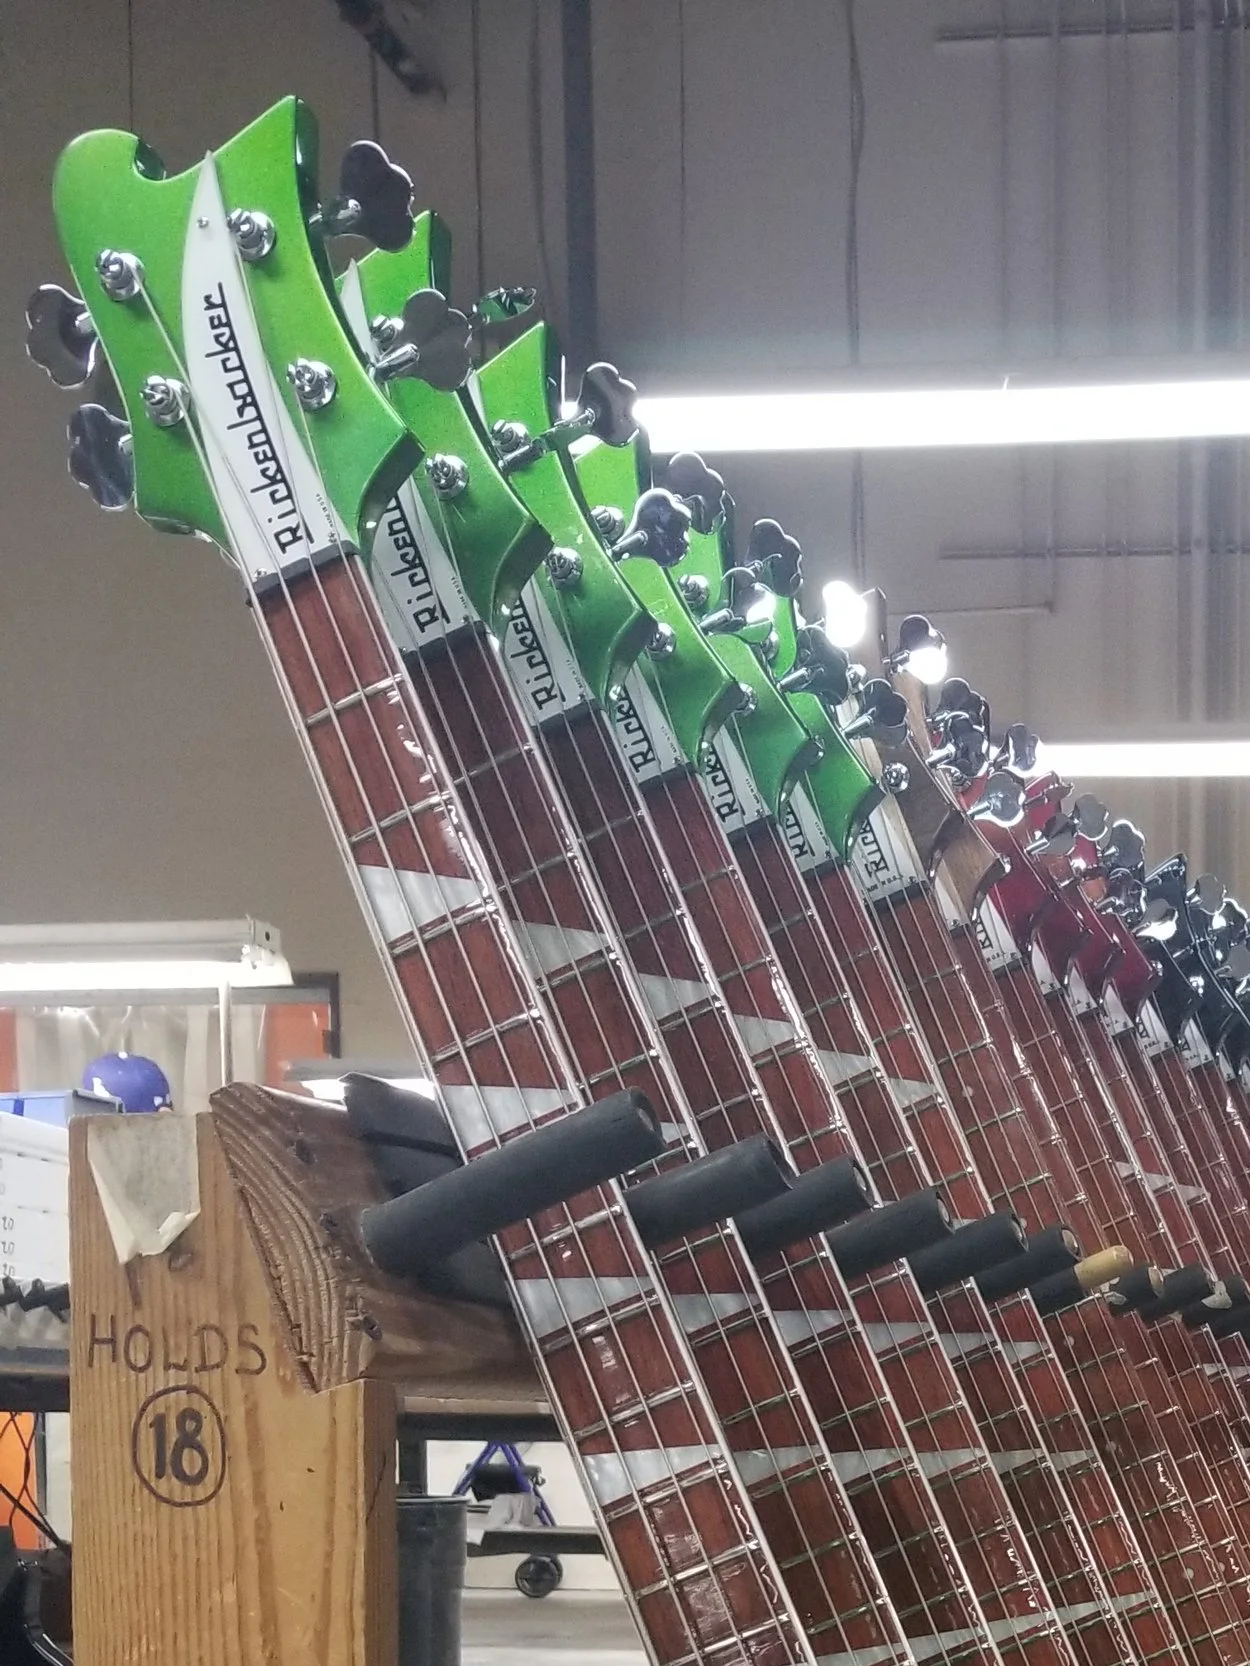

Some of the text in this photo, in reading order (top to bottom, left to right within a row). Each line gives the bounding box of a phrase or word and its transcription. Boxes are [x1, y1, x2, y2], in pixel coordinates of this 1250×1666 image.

[203, 282, 315, 553] Rickenbacker
[88, 1313, 268, 1376] HOLDS
[148, 1407, 210, 1487] 18
